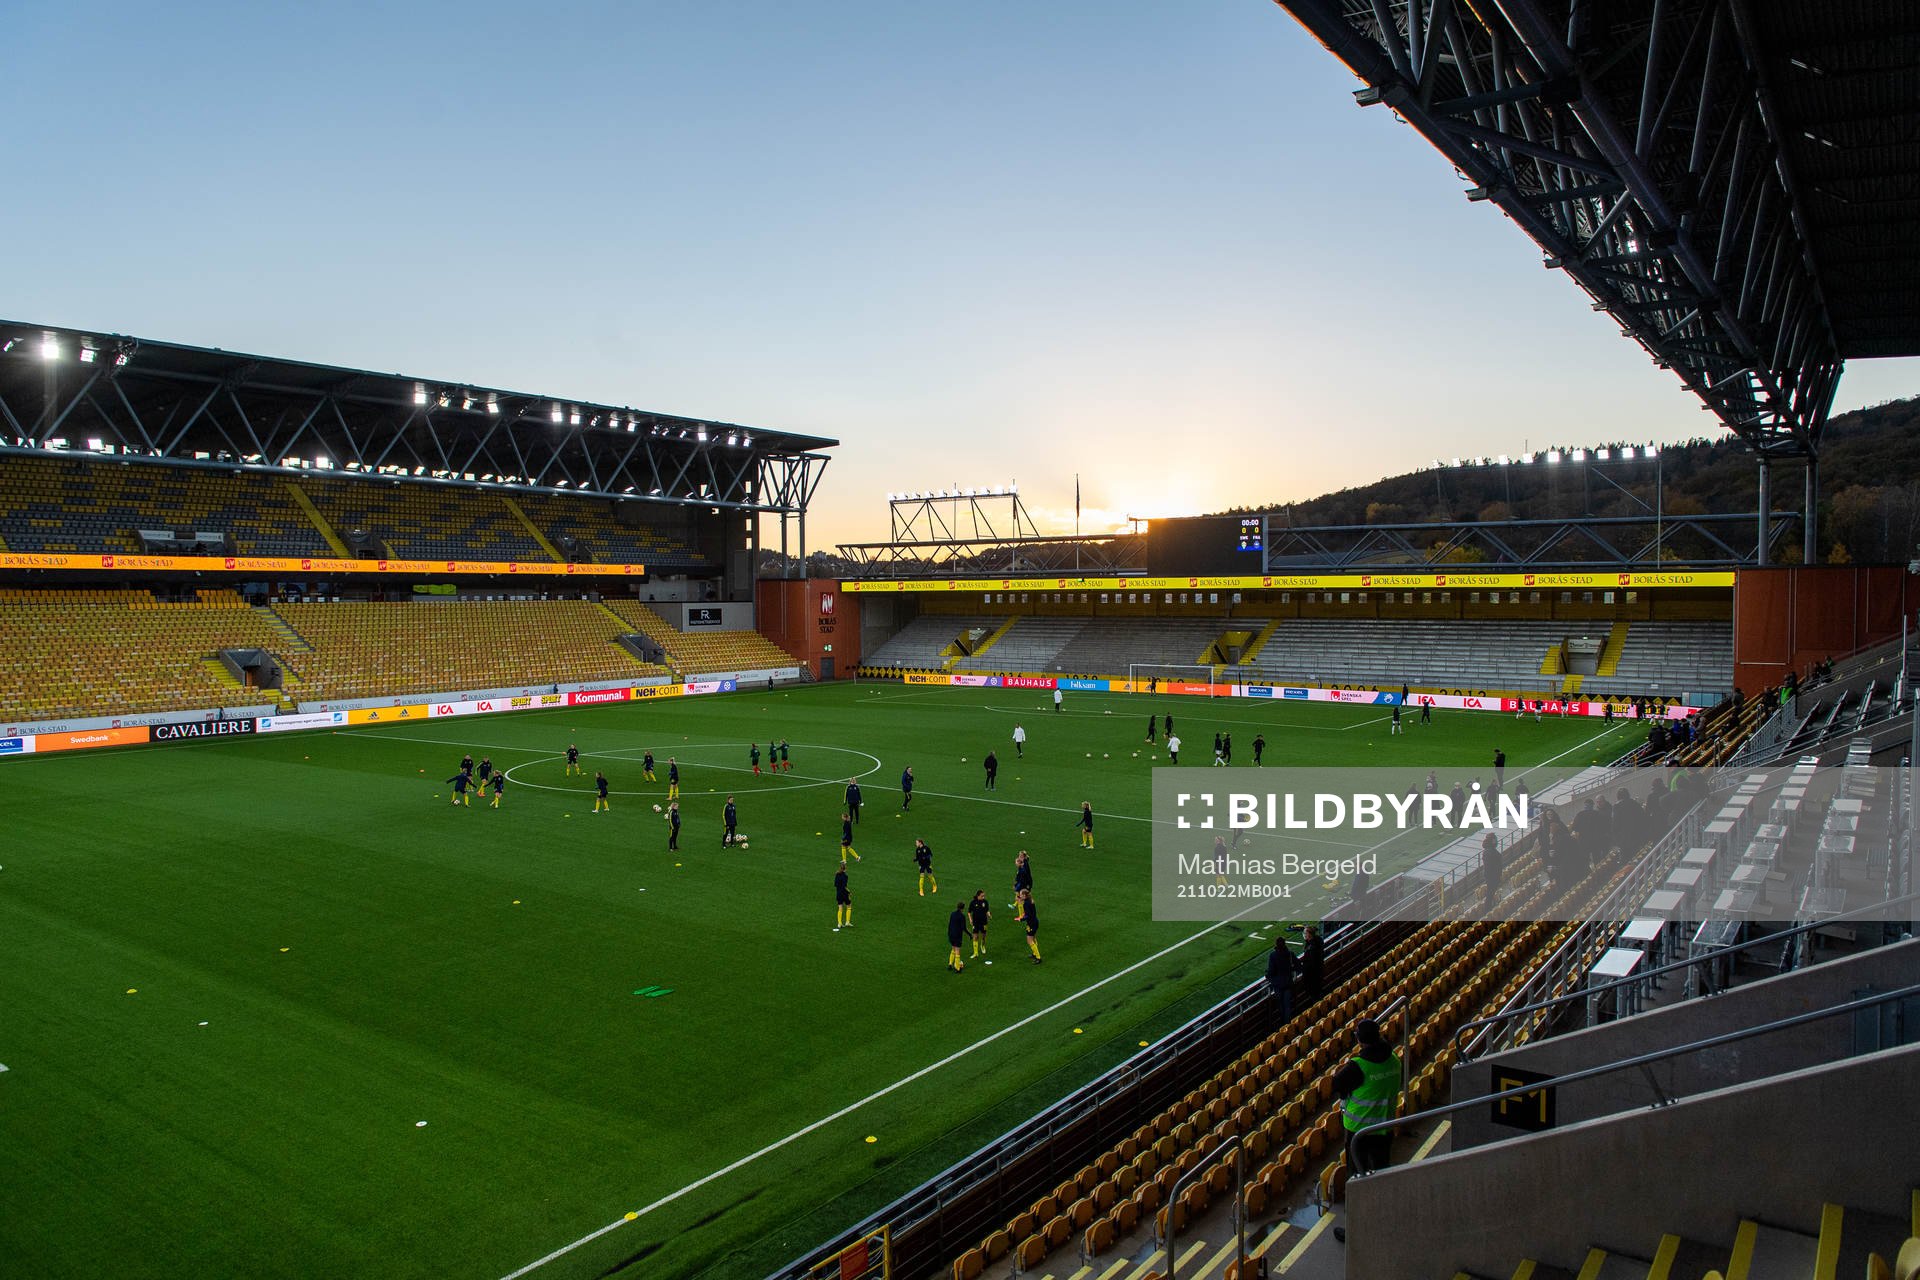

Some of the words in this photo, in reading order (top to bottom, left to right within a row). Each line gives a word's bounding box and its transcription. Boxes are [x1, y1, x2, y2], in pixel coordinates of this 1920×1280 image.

[5, 556, 40, 566] BORÅS
[42, 557, 68, 565] STAD
[117, 557, 149, 567] BORÅS
[150, 559, 173, 567] STAD
[1128, 579, 1148, 587] BORÅS
[1200, 578, 1222, 587] BORÅS
[1223, 579, 1240, 587] STAD
[1274, 576, 1298, 586] BORÅS
[1299, 577, 1318, 585] STAD
[1373, 576, 1399, 585] BORÅS
[1401, 577, 1421, 585] STAD
[1449, 575, 1476, 585] BORÅS
[1478, 576, 1500, 585] STAD
[1538, 574, 1568, 585] BORÅS
[1570, 576, 1593, 584] STAD
[1633, 574, 1666, 585] BORÅS
[1668, 575, 1693, 584] STAD
[1008, 679, 1052, 688] BAUHAUS
[575, 690, 624, 704] Kommunal.
[477, 701, 493, 712] ICA
[1463, 698, 1482, 708] ICA
[437, 705, 454, 715] ICA
[123, 718, 147, 727] BORÅS
[20, 726, 46, 735] BORÅS
[156, 720, 251, 739] CAVALIERE
[70, 734, 109, 744] Swedbank
[1500, 1077, 1546, 1124] F1
